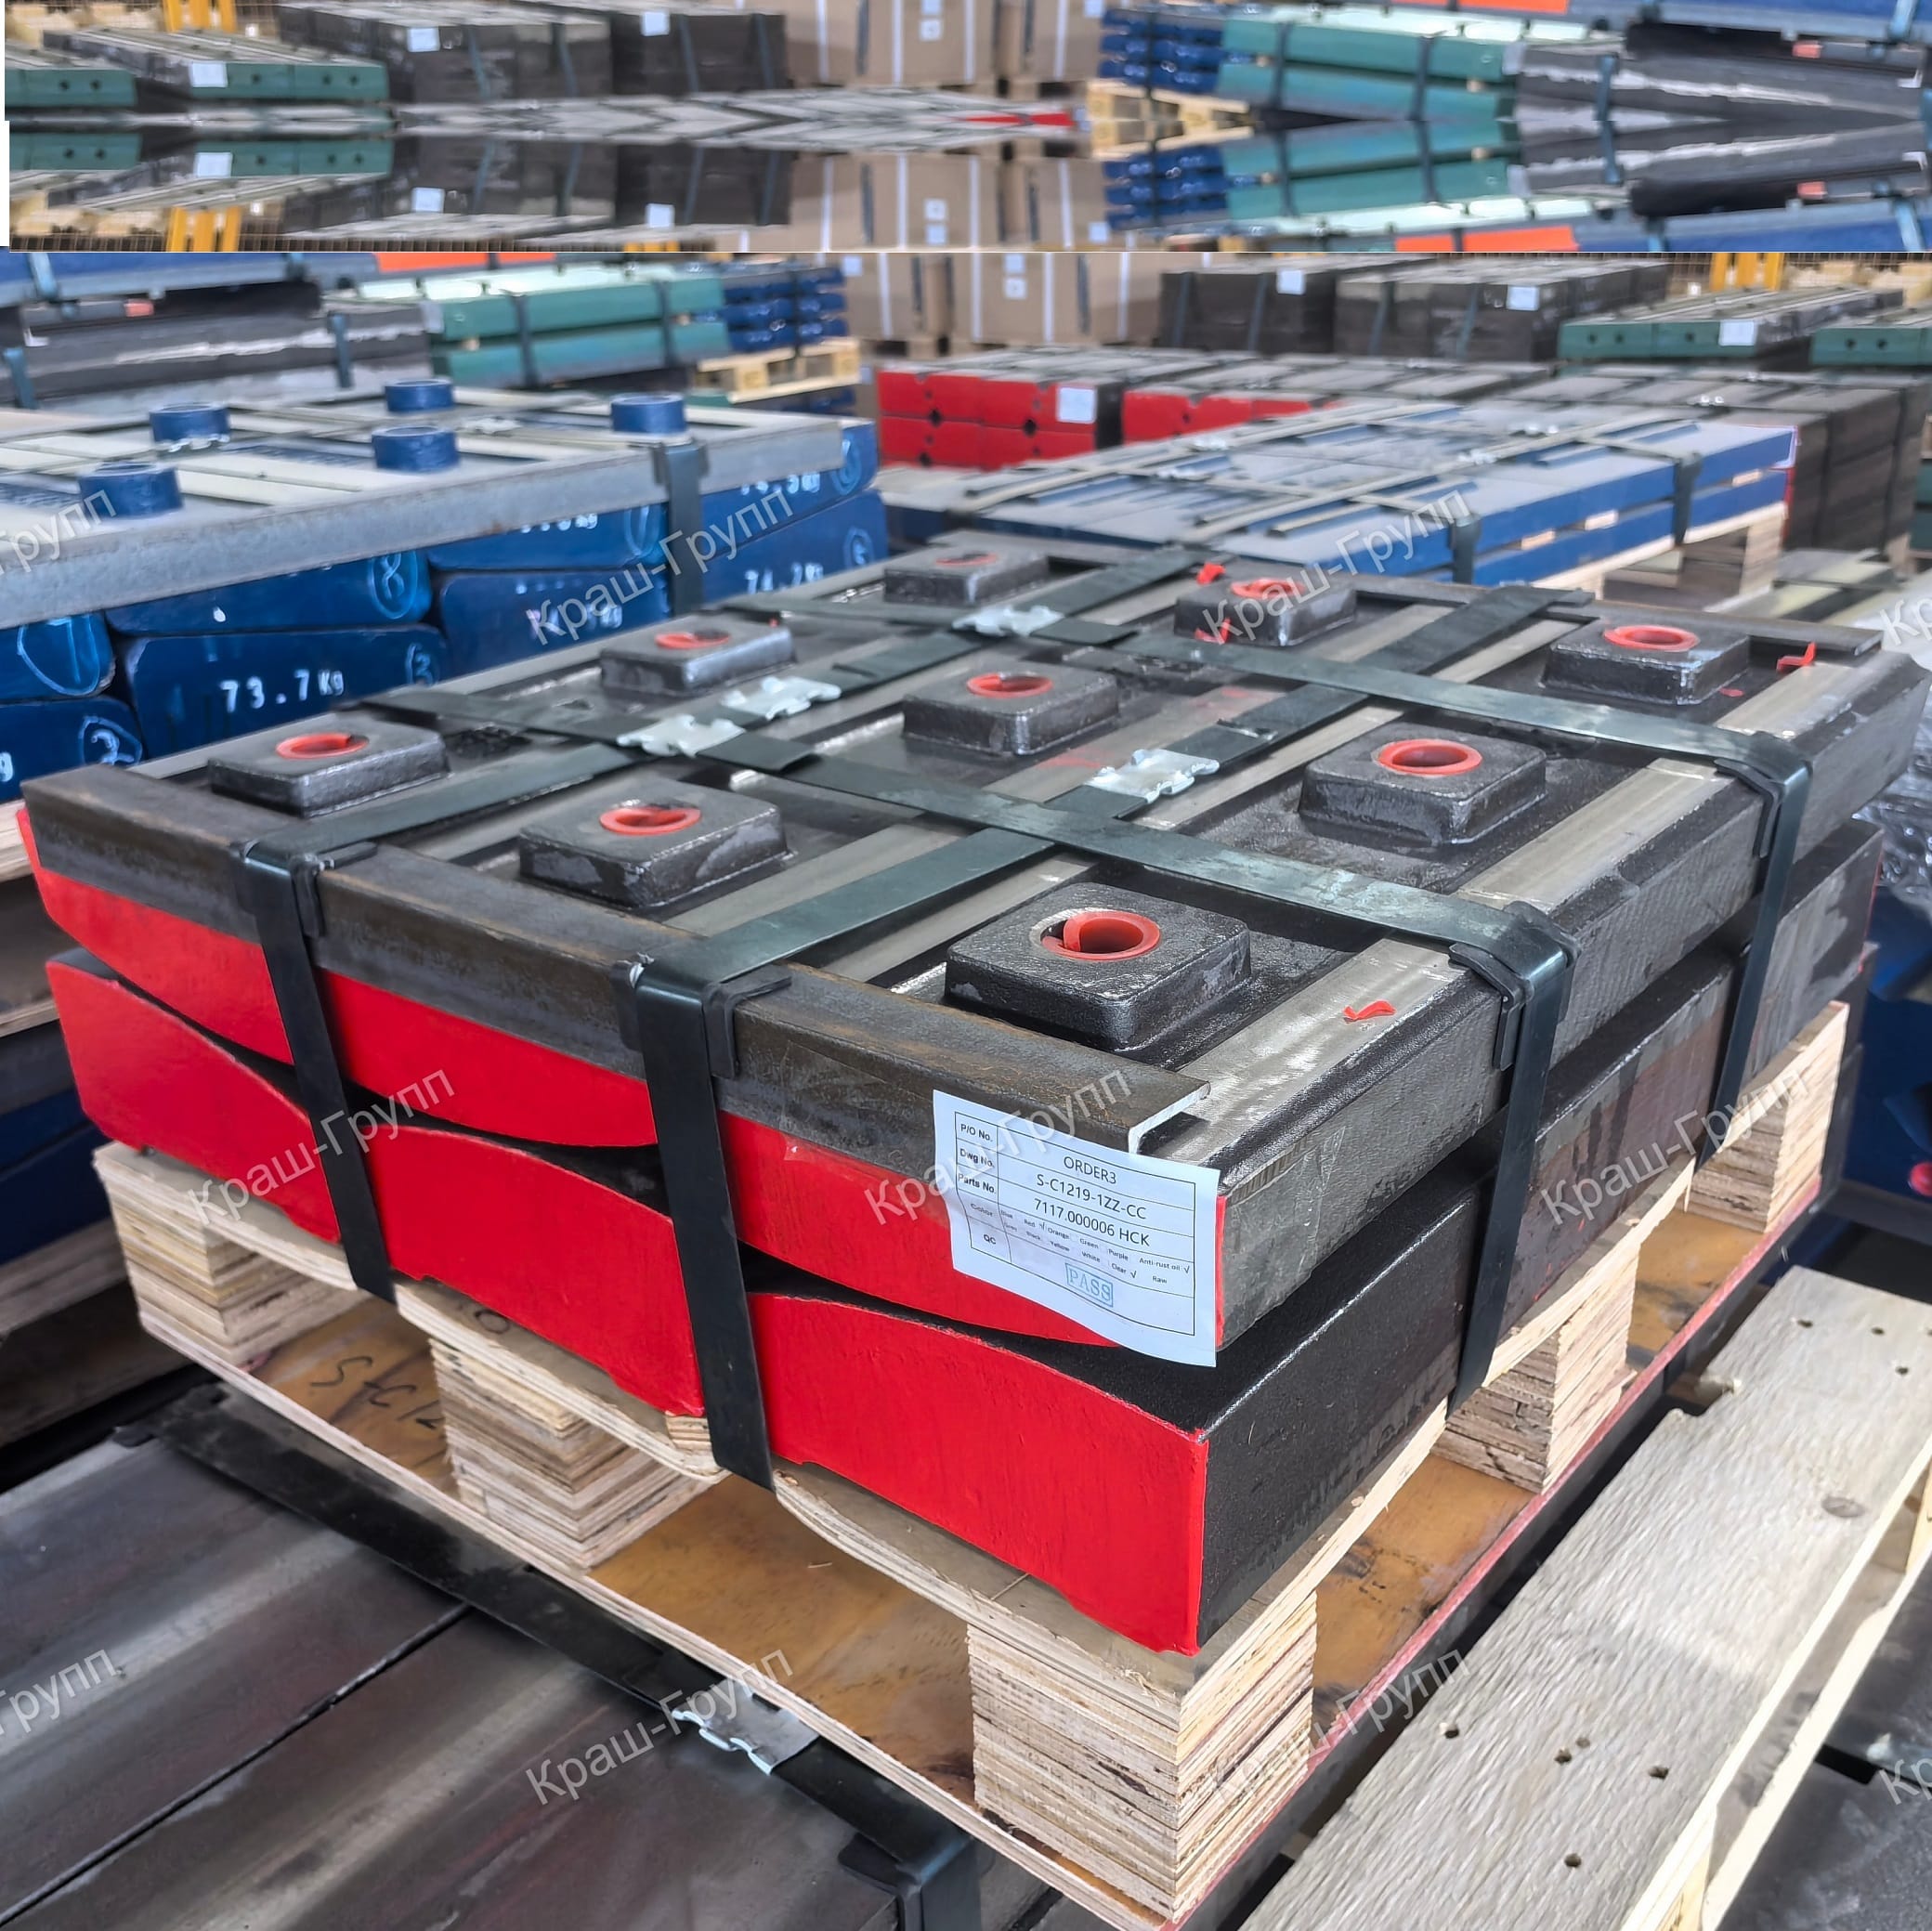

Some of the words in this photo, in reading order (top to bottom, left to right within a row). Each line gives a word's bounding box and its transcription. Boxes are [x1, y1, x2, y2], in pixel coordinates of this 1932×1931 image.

[960, 1123, 976, 1136] P/O
[978, 1129, 993, 1142] No.
[959, 1148, 979, 1165] Dwg
[981, 1155, 995, 1168] No.
[1064, 1156, 1116, 1184] ORDER3
[958, 1172, 980, 1188] Parts
[983, 1181, 997, 1194] No.
[1037, 1173, 1147, 1220] S-C1219-1ZZ-CC
[1034, 1198, 1116, 1237] 7117.000006
[1118, 1227, 1150, 1247] HCK
[983, 1233, 997, 1245] QC
[1108, 1248, 1129, 1261] Purple
[1069, 1267, 1111, 1301] PASS
